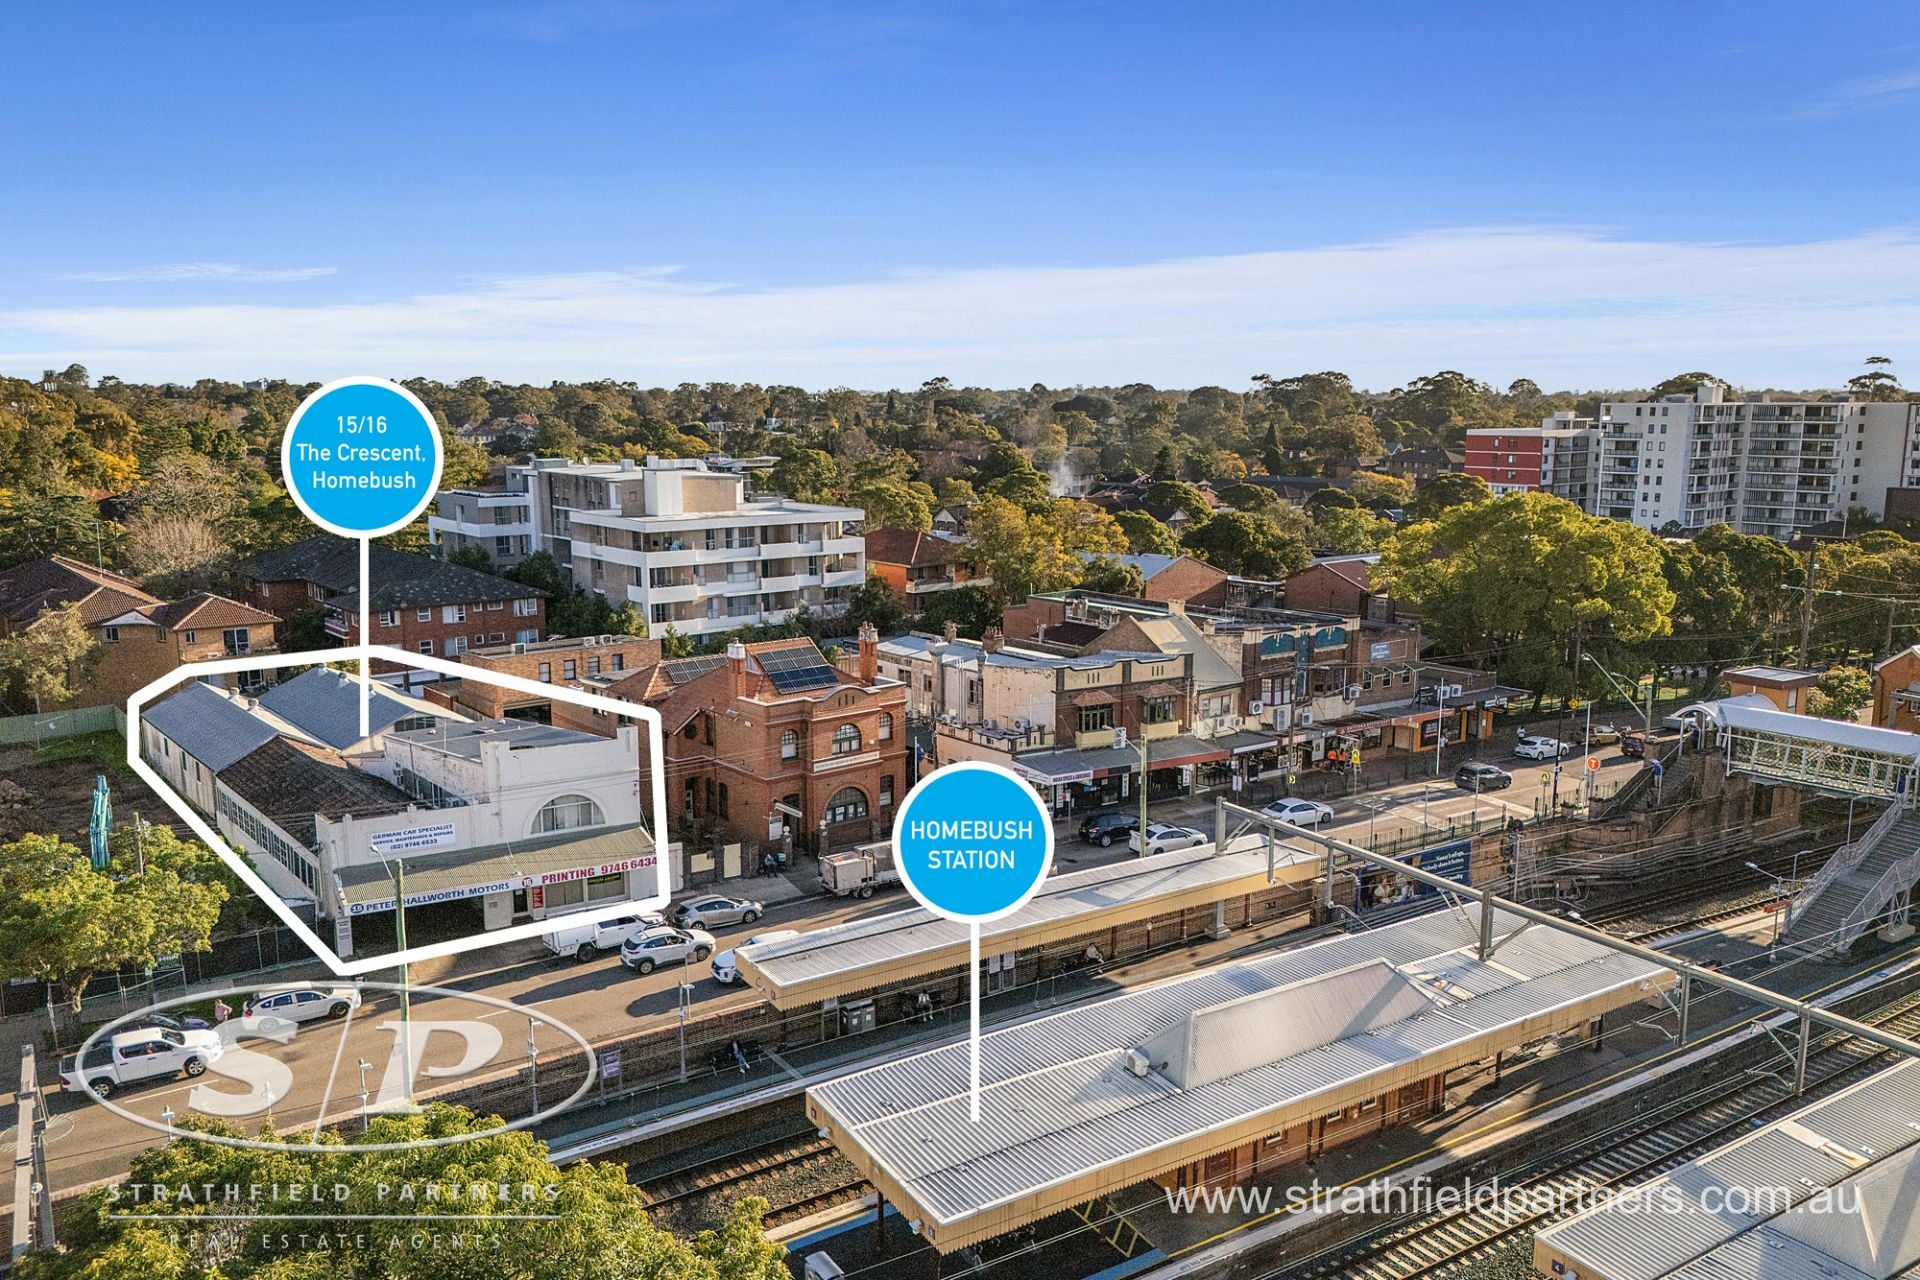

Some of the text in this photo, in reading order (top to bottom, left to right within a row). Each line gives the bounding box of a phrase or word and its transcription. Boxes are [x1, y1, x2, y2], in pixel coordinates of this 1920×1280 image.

[372, 824, 453, 840] GERMAN CAR SPECIALIST
[390, 842, 404, 850] (02)
[404, 840, 420, 848] 9746
[541, 866, 595, 885] PRINTING
[601, 861, 628, 875] 9746
[630, 856, 657, 870] 6434
[366, 900, 396, 911] PETER
[404, 889, 464, 906] HALLWORTH
[469, 882, 510, 895] MOTORS
